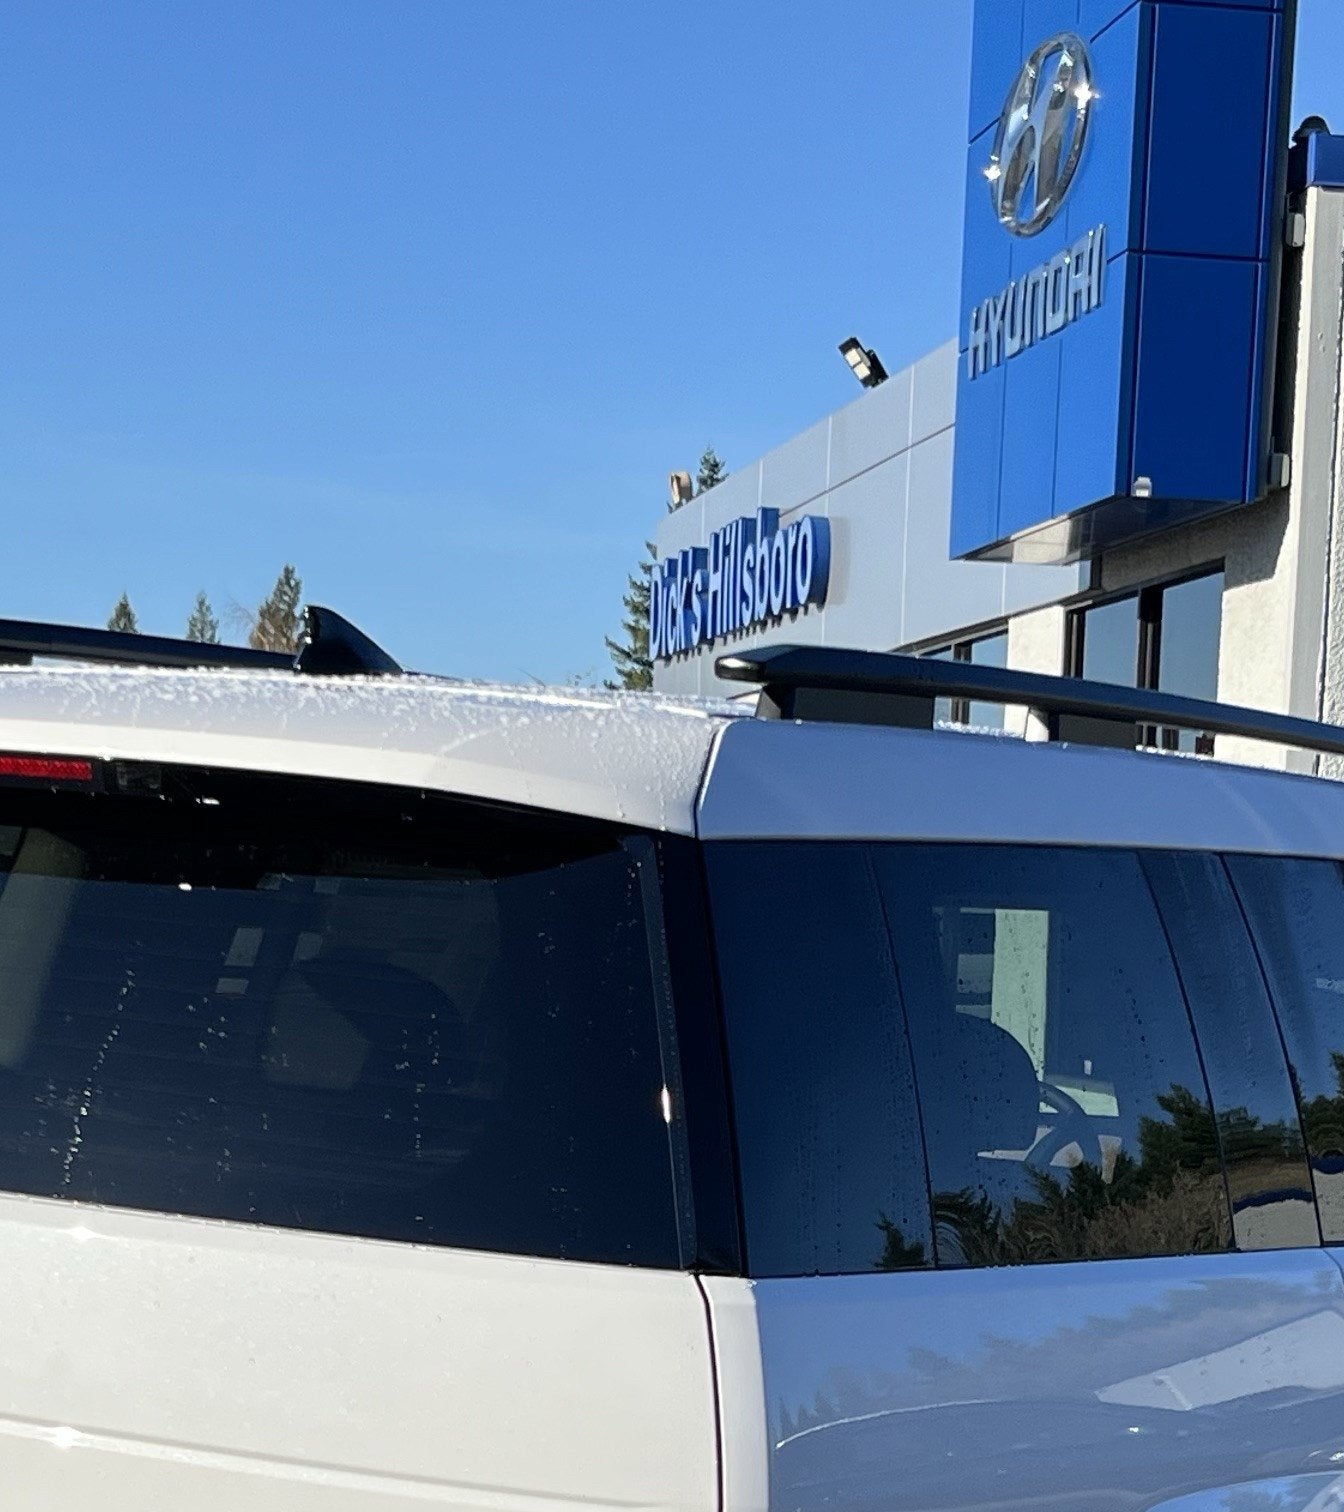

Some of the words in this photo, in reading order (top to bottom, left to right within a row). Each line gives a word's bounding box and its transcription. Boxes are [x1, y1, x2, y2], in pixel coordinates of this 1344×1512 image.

[968, 223, 1106, 381] HYUNDAI
[648, 546, 704, 661] Dick's
[707, 507, 816, 640] Hillsboro
